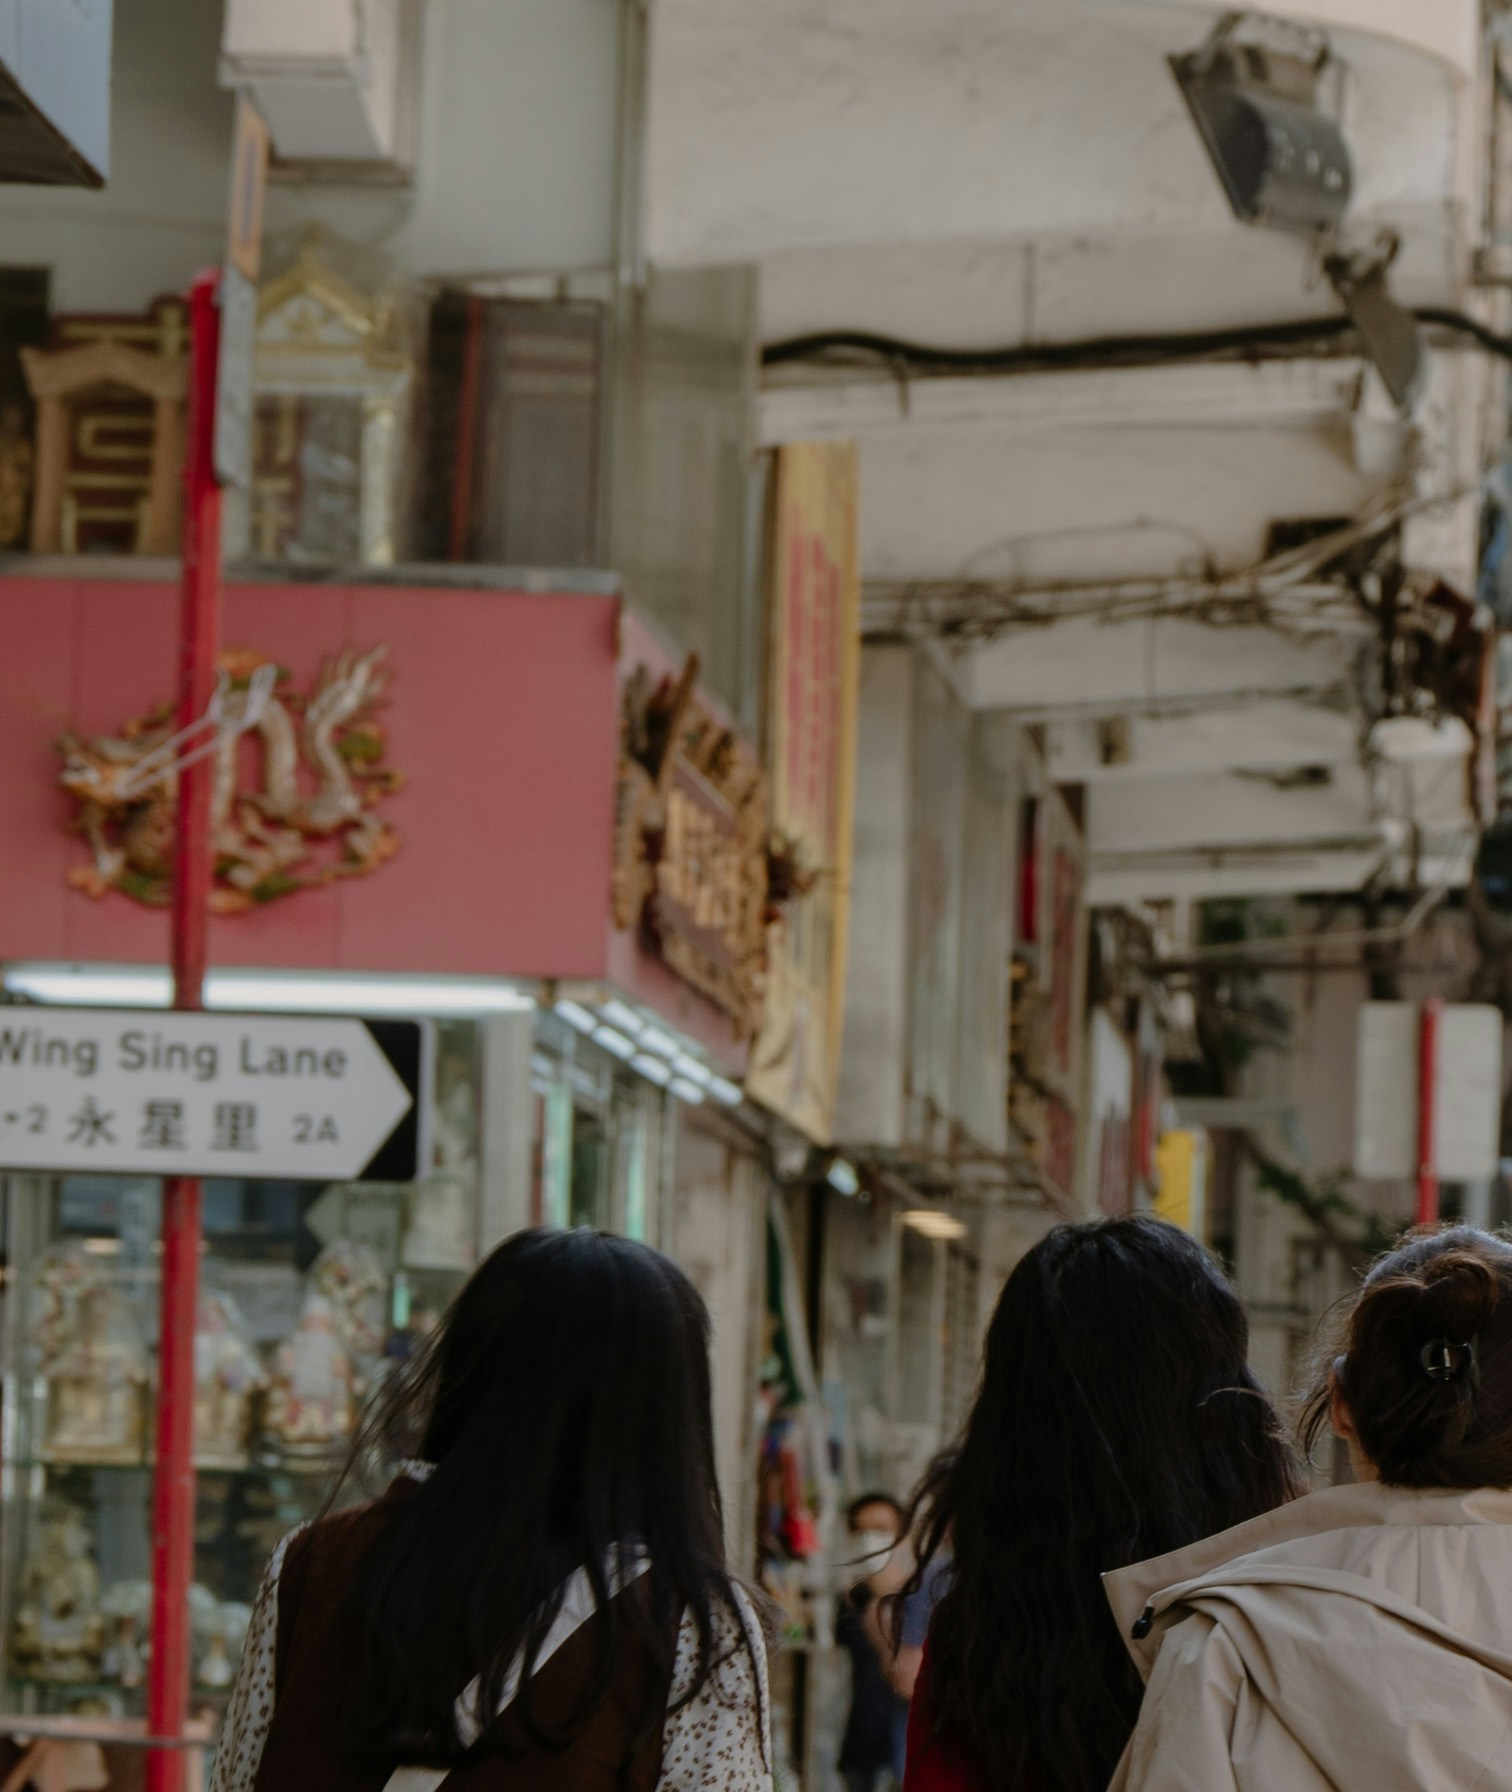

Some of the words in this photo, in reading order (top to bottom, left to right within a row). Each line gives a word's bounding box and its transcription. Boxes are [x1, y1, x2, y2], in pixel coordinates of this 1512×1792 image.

[119, 1031, 218, 1083] Sing
[241, 1037, 347, 1078] Lane
[65, 1095, 259, 1152] 永星里
[293, 1113, 339, 1144] 2A
